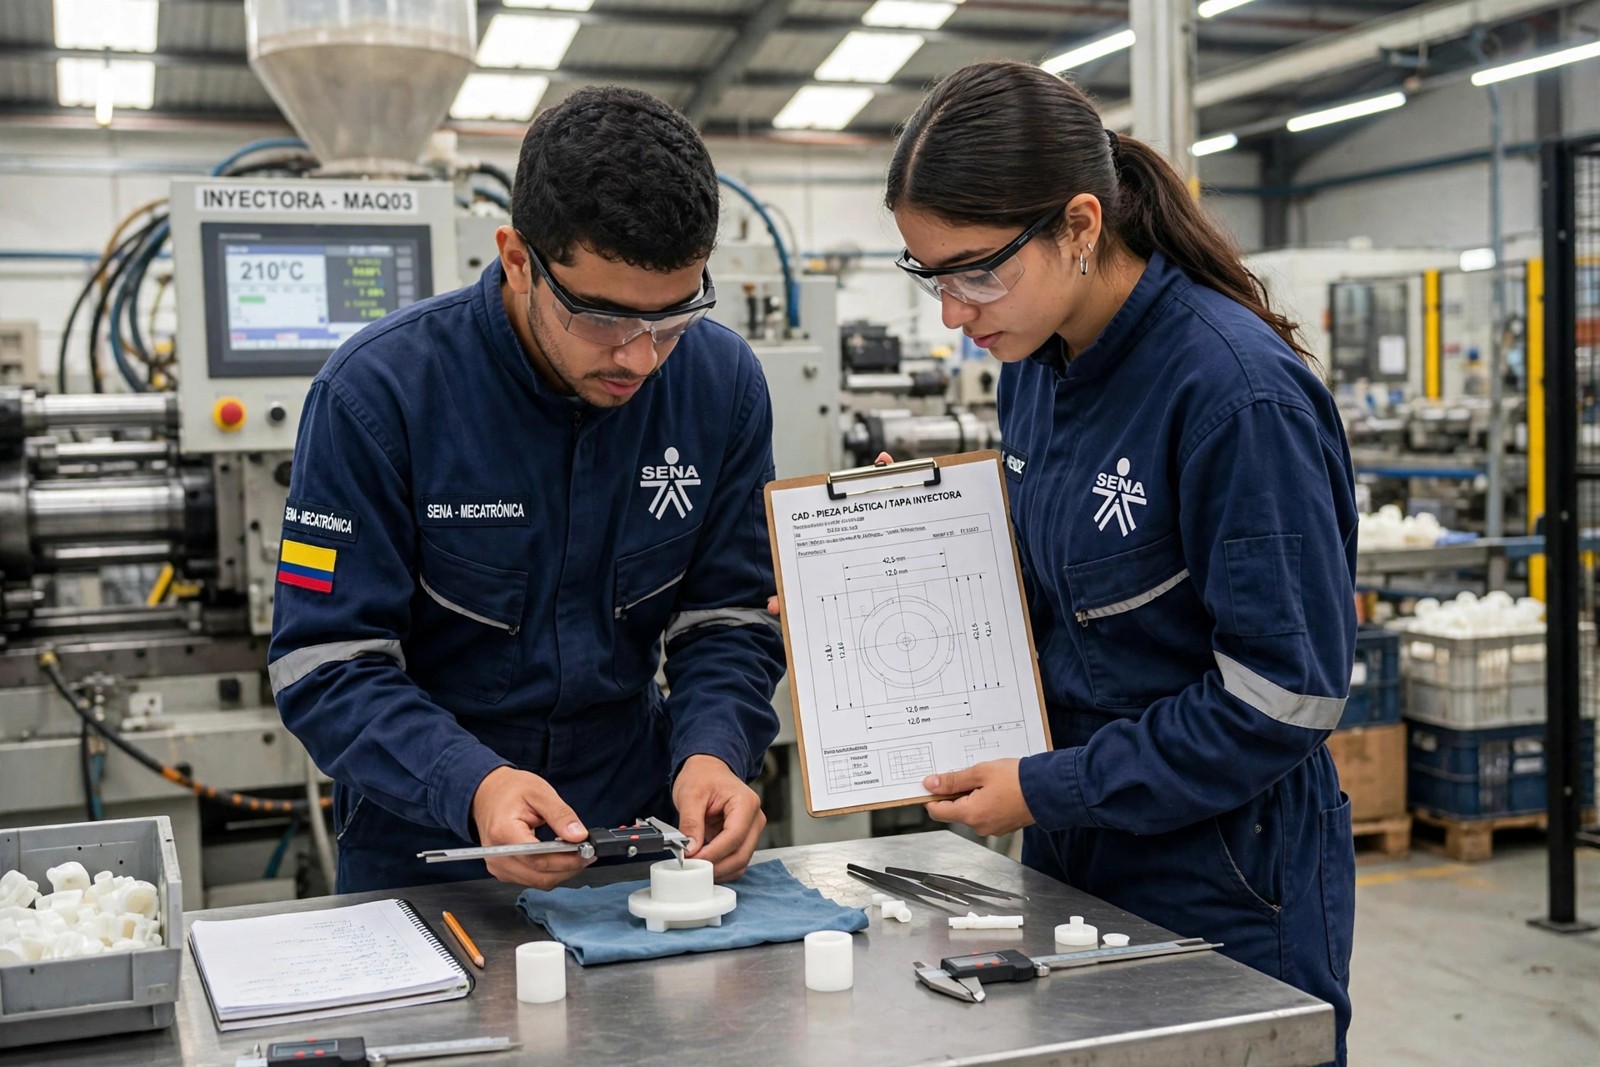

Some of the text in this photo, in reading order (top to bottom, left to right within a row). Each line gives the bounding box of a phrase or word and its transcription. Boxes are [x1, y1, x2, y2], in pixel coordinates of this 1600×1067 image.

[203, 190, 325, 209] INYECTORA
[343, 192, 413, 211] MAQ03
[240, 260, 304, 281] 210°C
[641, 465, 699, 480] SENA
[1095, 472, 1146, 497] SENA
[427, 503, 453, 519] SENA
[460, 500, 525, 519] MECATRÓNICA
[791, 512, 810, 522] CAD
[816, 508, 842, 519] PIEZA
[842, 501, 883, 515] PLÁSTICA
[888, 497, 912, 508] TAPA
[912, 490, 962, 505] INYECTORA
[300, 512, 352, 534] MECATRÓNICA
